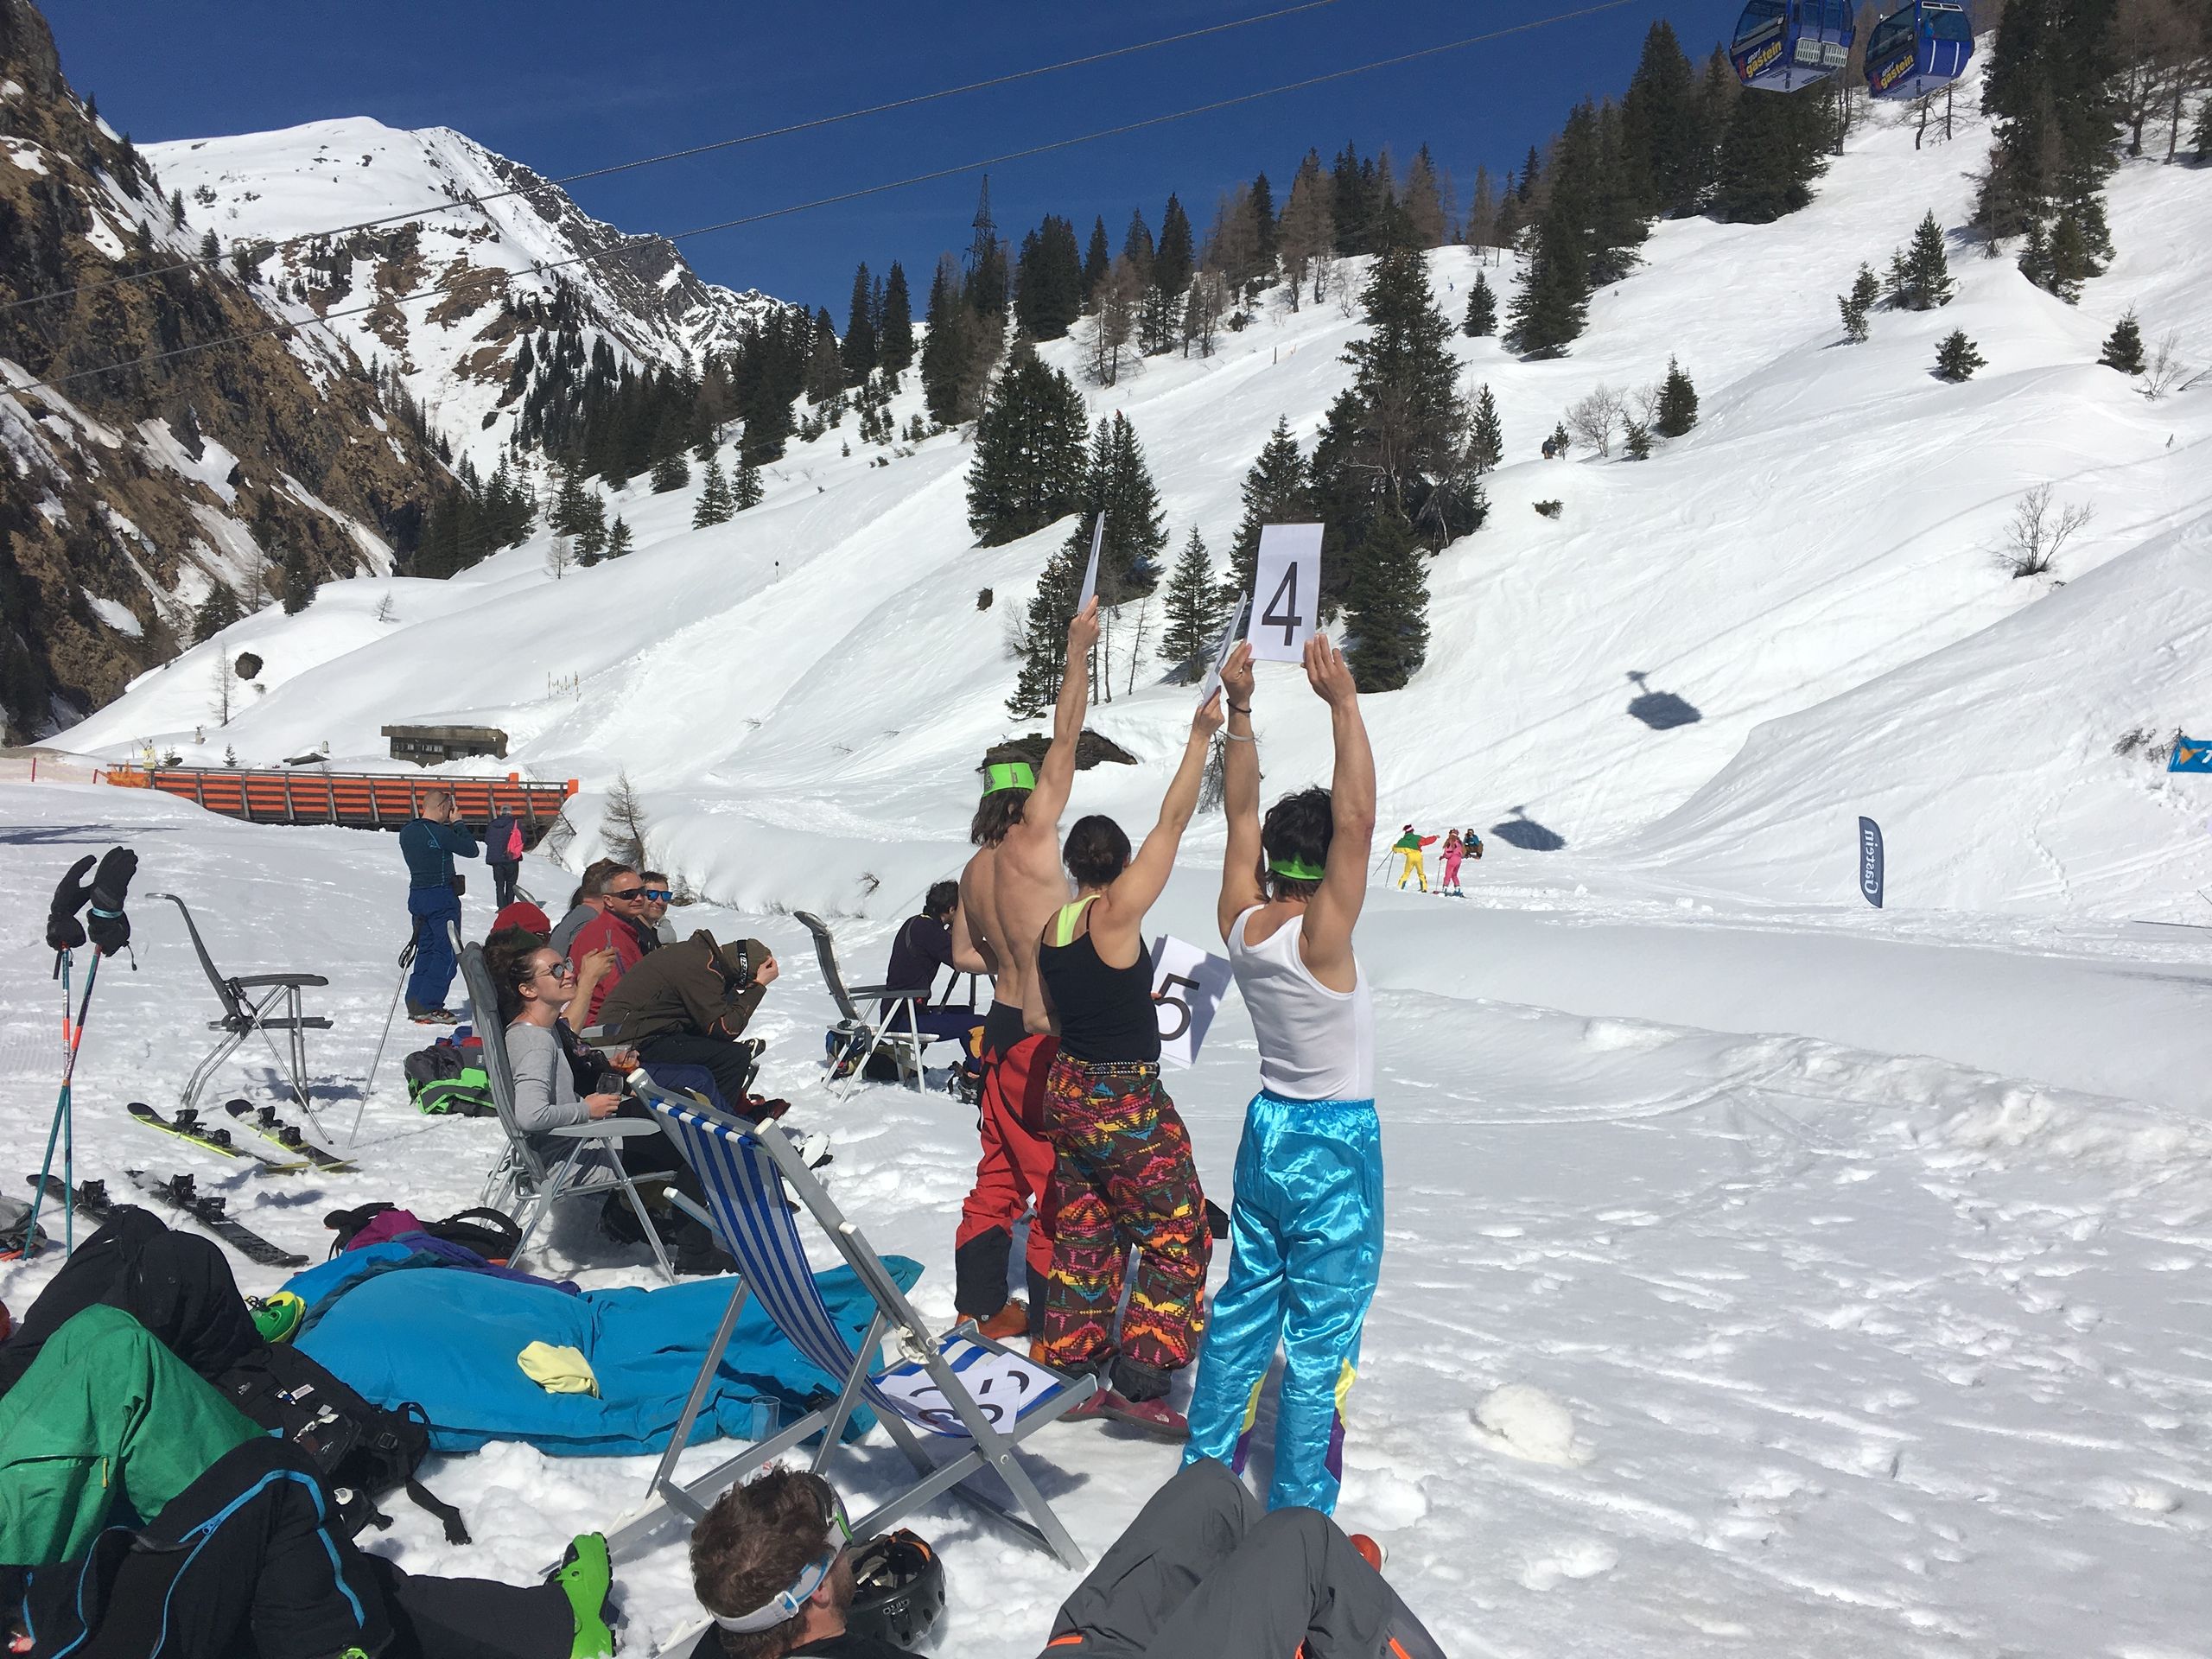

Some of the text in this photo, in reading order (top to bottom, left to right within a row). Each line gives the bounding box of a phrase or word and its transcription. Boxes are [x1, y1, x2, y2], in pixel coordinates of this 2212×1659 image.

[1746, 41, 1782, 78] gastein
[1880, 54, 1914, 89] gastein
[1262, 562, 1302, 646] 4
[1153, 973, 1200, 1041] 5
